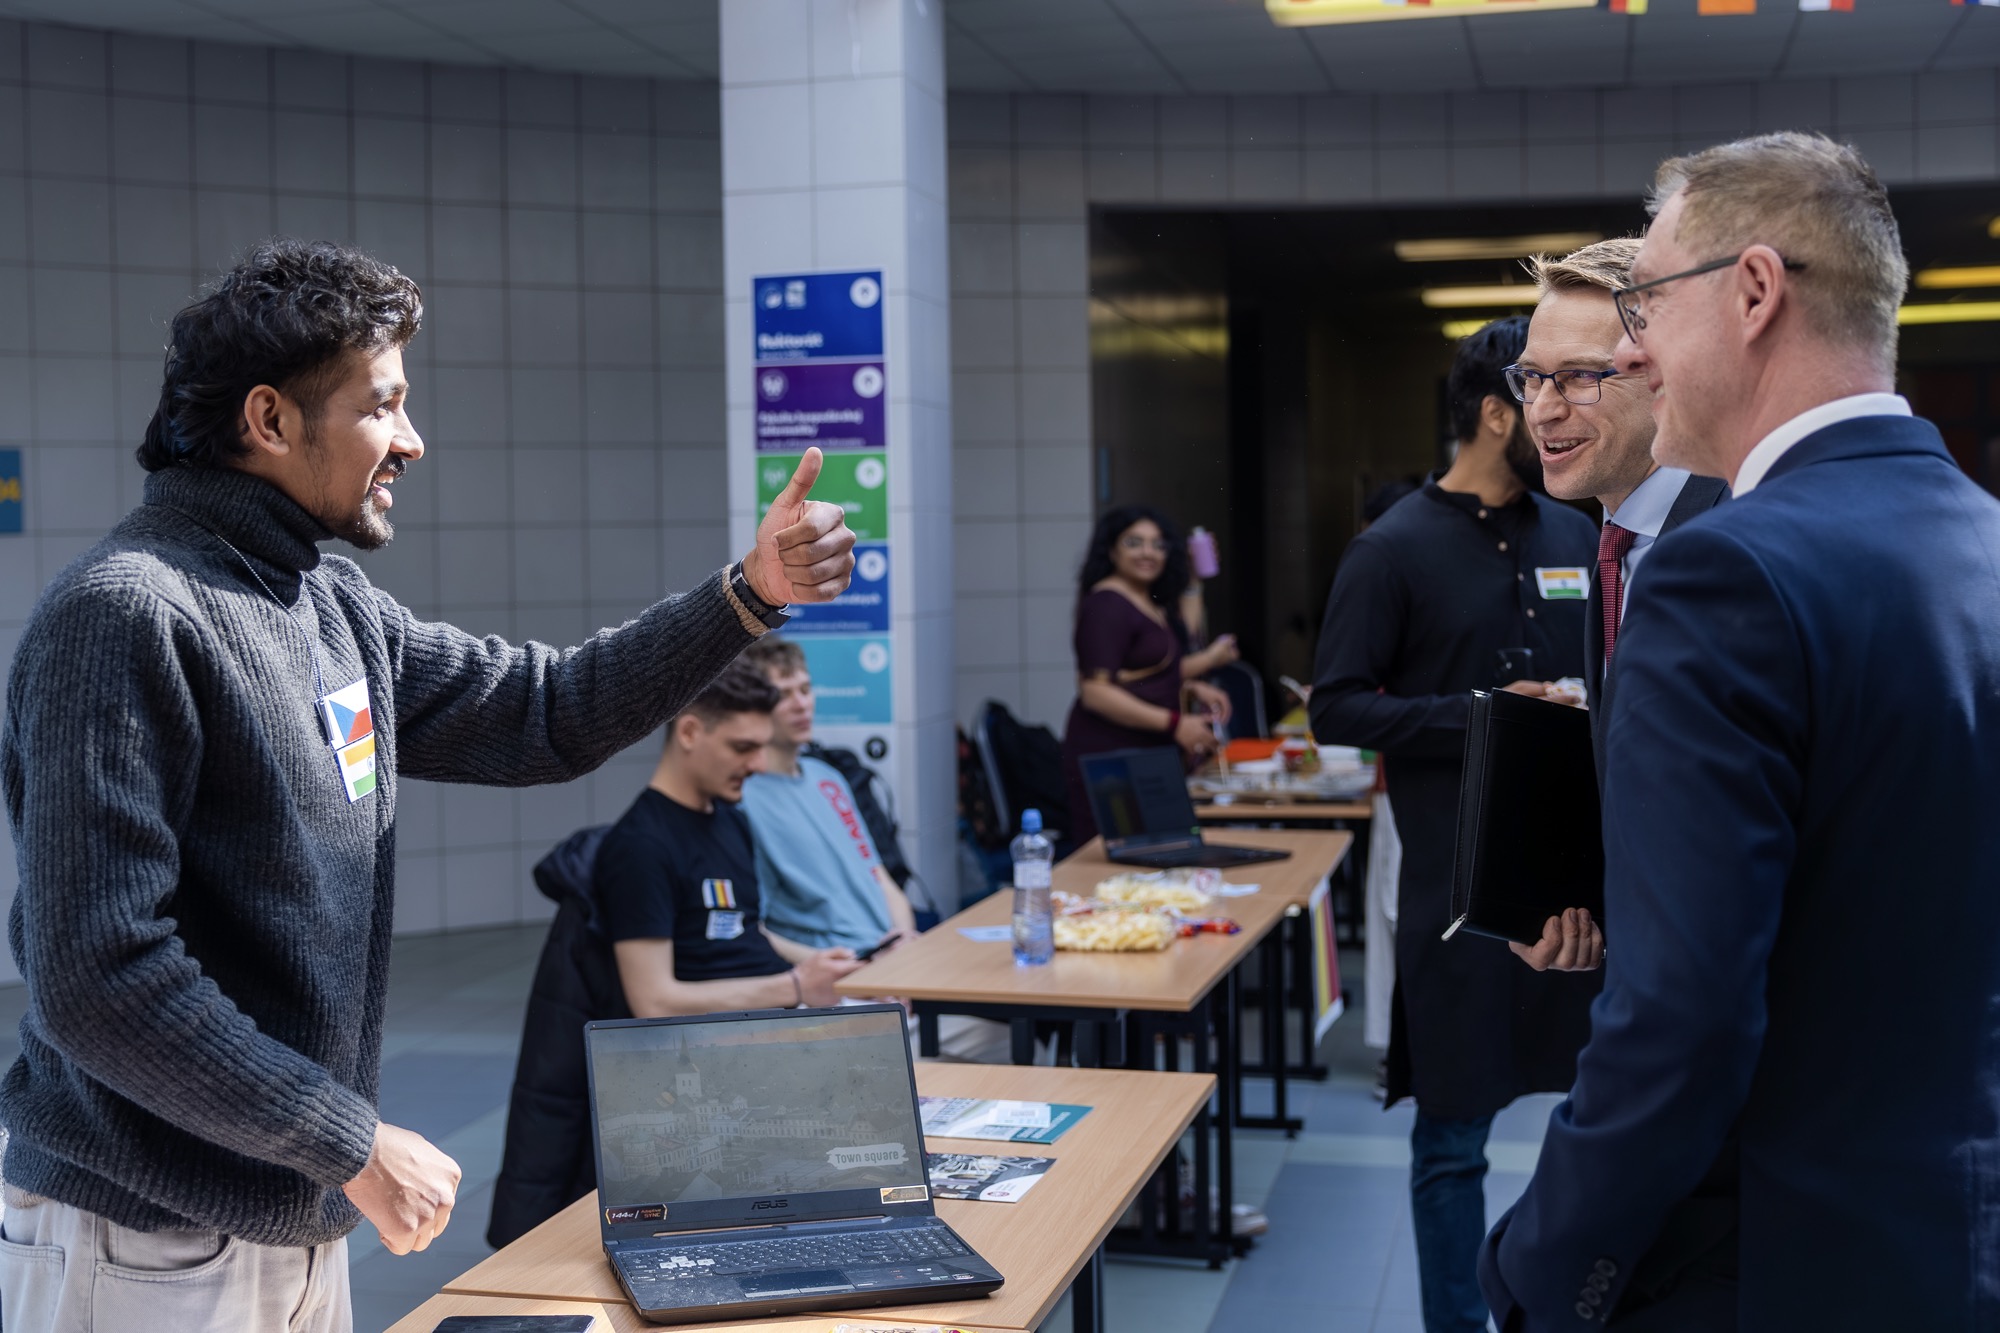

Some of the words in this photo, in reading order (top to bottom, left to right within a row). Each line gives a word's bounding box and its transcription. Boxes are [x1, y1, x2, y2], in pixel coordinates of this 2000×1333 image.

[835, 1152, 862, 1165] Town
[864, 1150, 899, 1164] square
[751, 1199, 788, 1211] ASUS
